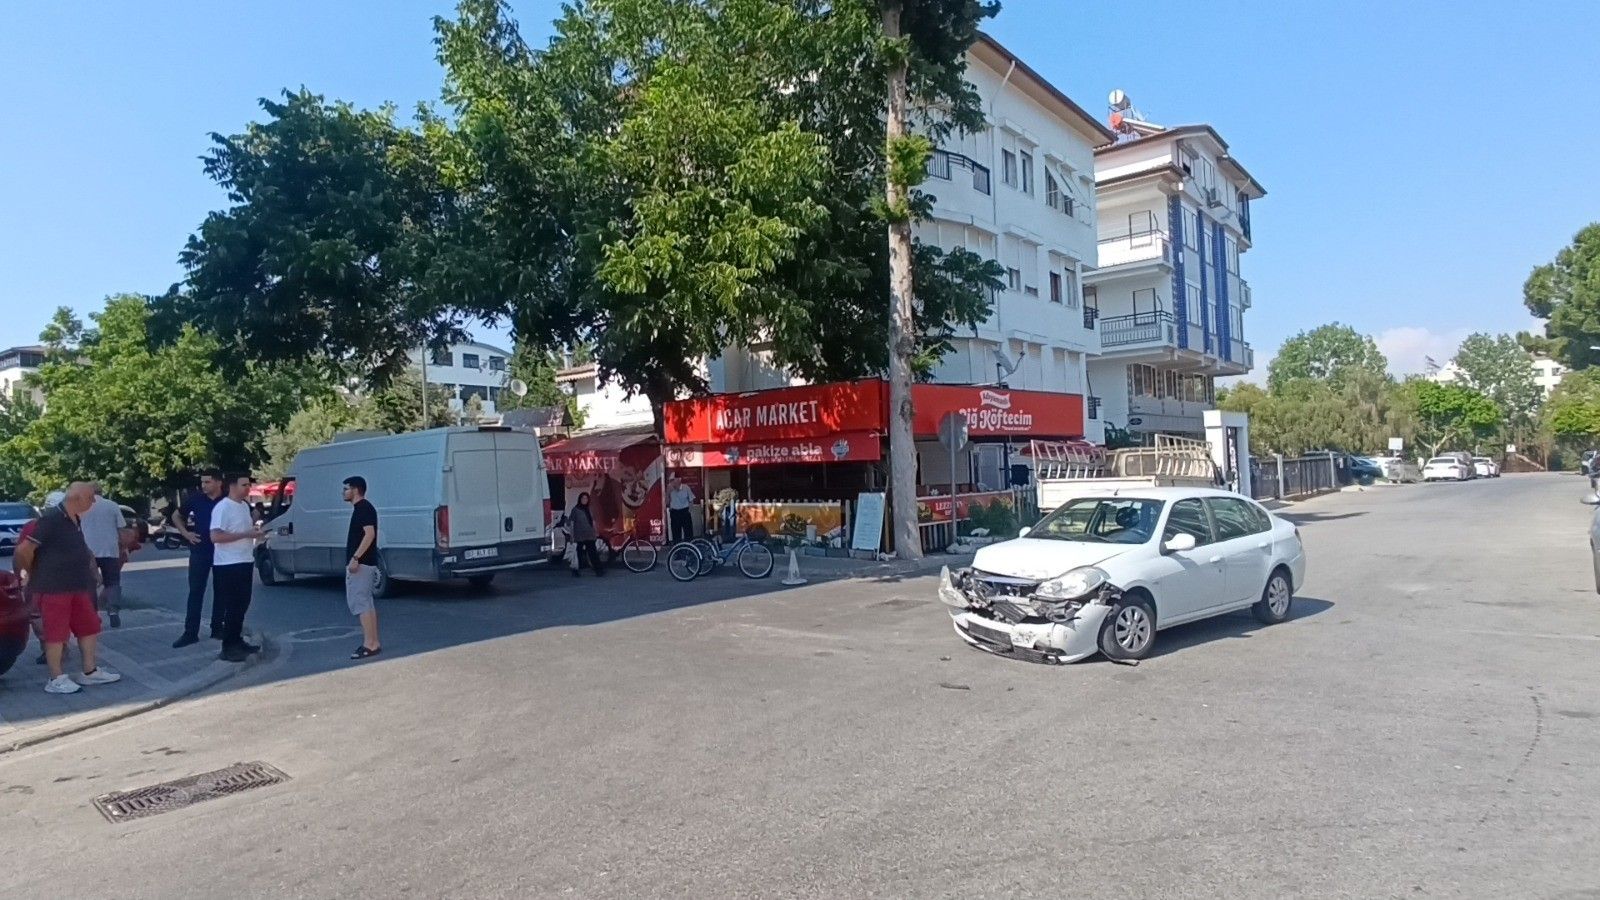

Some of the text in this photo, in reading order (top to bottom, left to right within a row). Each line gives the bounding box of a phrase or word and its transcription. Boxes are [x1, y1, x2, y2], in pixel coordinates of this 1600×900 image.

[716, 400, 818, 429] ACAR MARKET
[980, 408, 1032, 431] Köftecim
[747, 445, 789, 460] pakize
[791, 443, 823, 456] abla
[568, 456, 618, 470] MARKET
